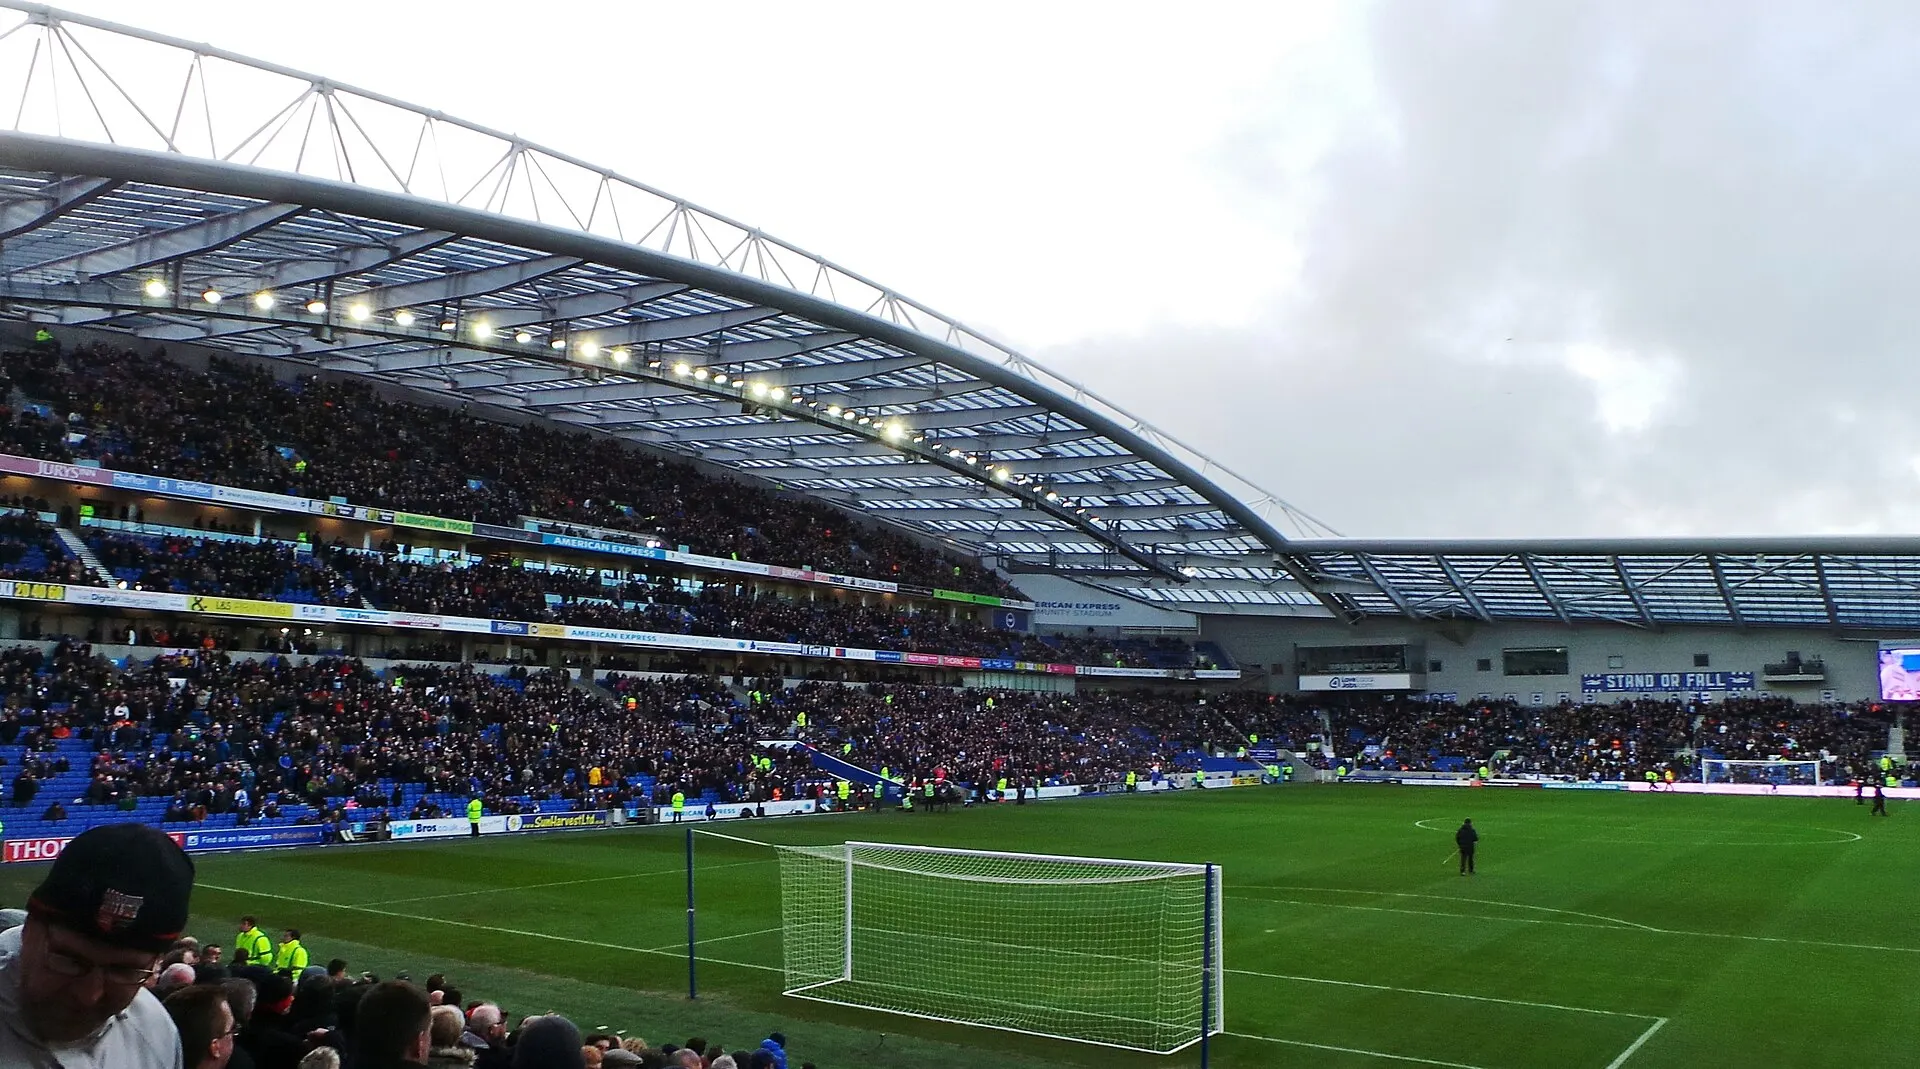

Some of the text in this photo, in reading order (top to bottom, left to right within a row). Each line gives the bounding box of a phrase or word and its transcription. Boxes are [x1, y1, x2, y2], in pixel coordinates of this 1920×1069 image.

[36, 461, 80, 479] JURYS
[553, 537, 656, 558] AMERICAN EXPRESS
[1035, 601, 1073, 609] ERICAN
[571, 630, 618, 639] AMERICAN
[619, 633, 657, 642] EXPRESS
[1606, 673, 1726, 688] STAND OR FALL
[202, 836, 217, 844] Find
[238, 834, 272, 843] Instagram
